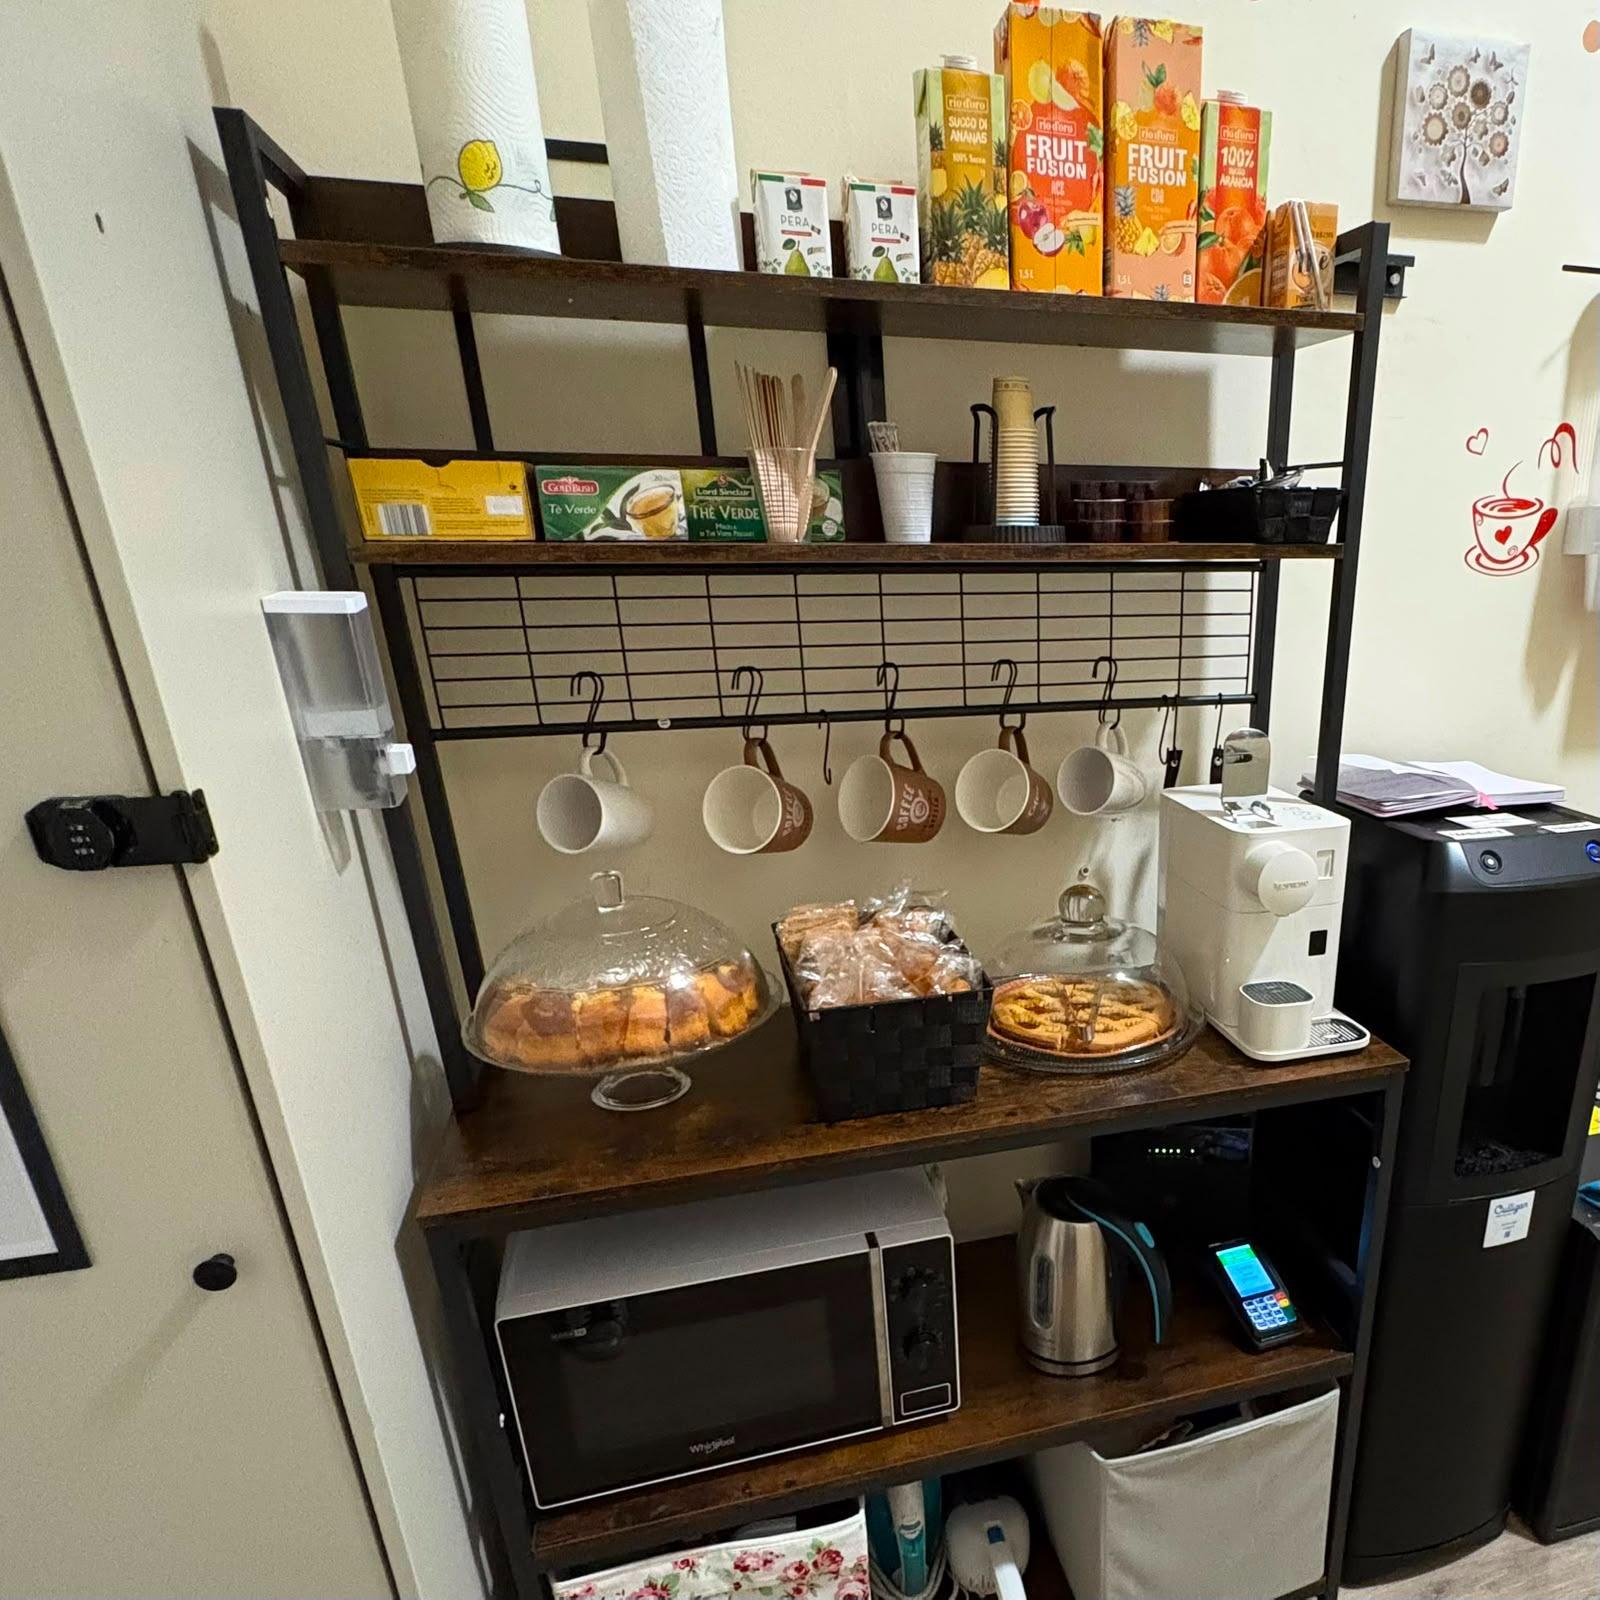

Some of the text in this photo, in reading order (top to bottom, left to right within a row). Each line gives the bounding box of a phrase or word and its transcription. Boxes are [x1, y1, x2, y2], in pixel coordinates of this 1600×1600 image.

[948, 115, 988, 131] SUCCO DI
[950, 129, 988, 145] ANANAS
[1025, 133, 1087, 163] FRUIT
[1127, 143, 1187, 171] FRUIT
[1221, 146, 1255, 168] 100%
[1026, 157, 1087, 180] FUSION
[1128, 166, 1187, 187] FUSION
[1219, 174, 1254, 190] ARANCIA
[780, 214, 810, 228] PERA
[871, 222, 899, 236] PERA
[697, 487, 752, 497] Lord Sinclair
[565, 504, 597, 515] Verde
[719, 505, 761, 521] VERDE
[689, 1436, 736, 1454] Whirlpool
